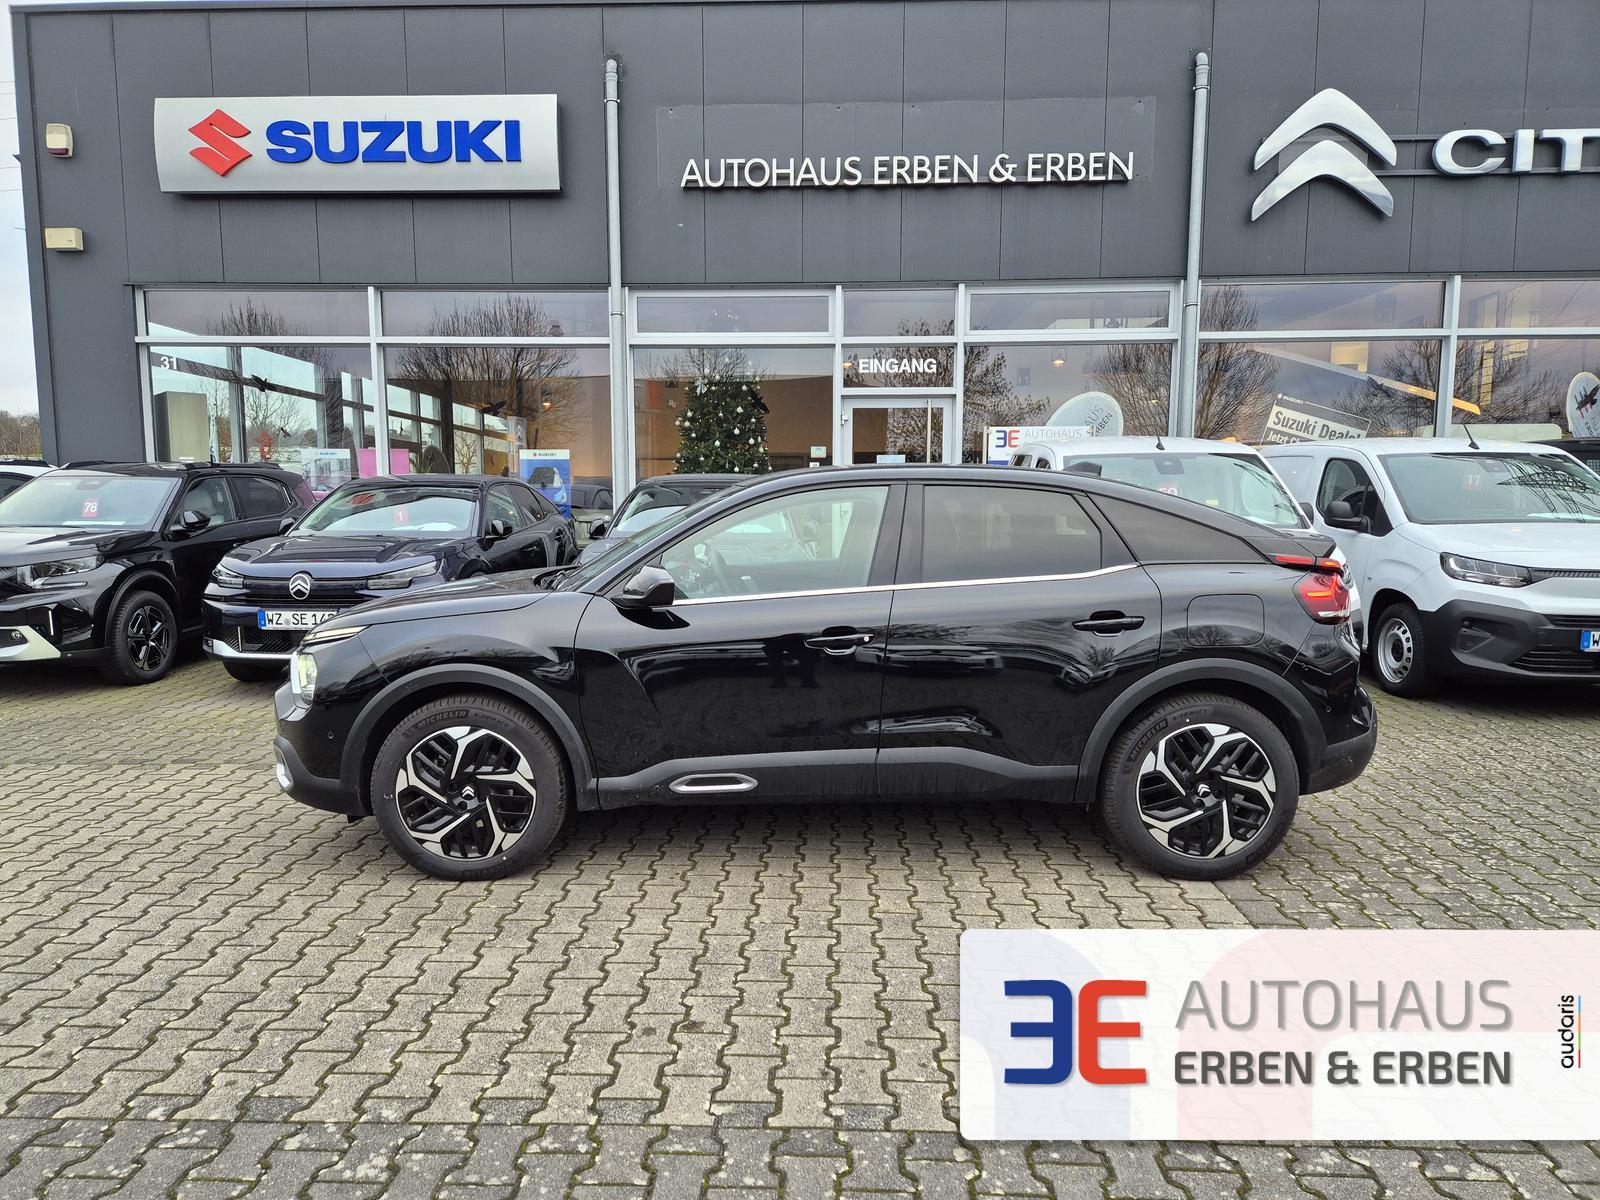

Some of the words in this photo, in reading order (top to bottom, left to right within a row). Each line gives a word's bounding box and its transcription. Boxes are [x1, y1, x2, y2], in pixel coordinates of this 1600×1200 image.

[266, 120, 521, 163] SUZUKI
[680, 156, 863, 188] AUTOHAUS
[874, 154, 979, 184] ERBEN
[989, 153, 1017, 183] &
[1027, 151, 1134, 182] ERBEN
[160, 356, 178, 370] 31
[859, 358, 937, 373] EINGANG
[1273, 410, 1318, 436] Suzuki
[1024, 429, 1082, 439] AUTOHAUS
[84, 502, 98, 513] 78
[266, 613, 283, 626] WZ
[292, 613, 308, 626] SE
[417, 709, 469, 729] MICHELIN
